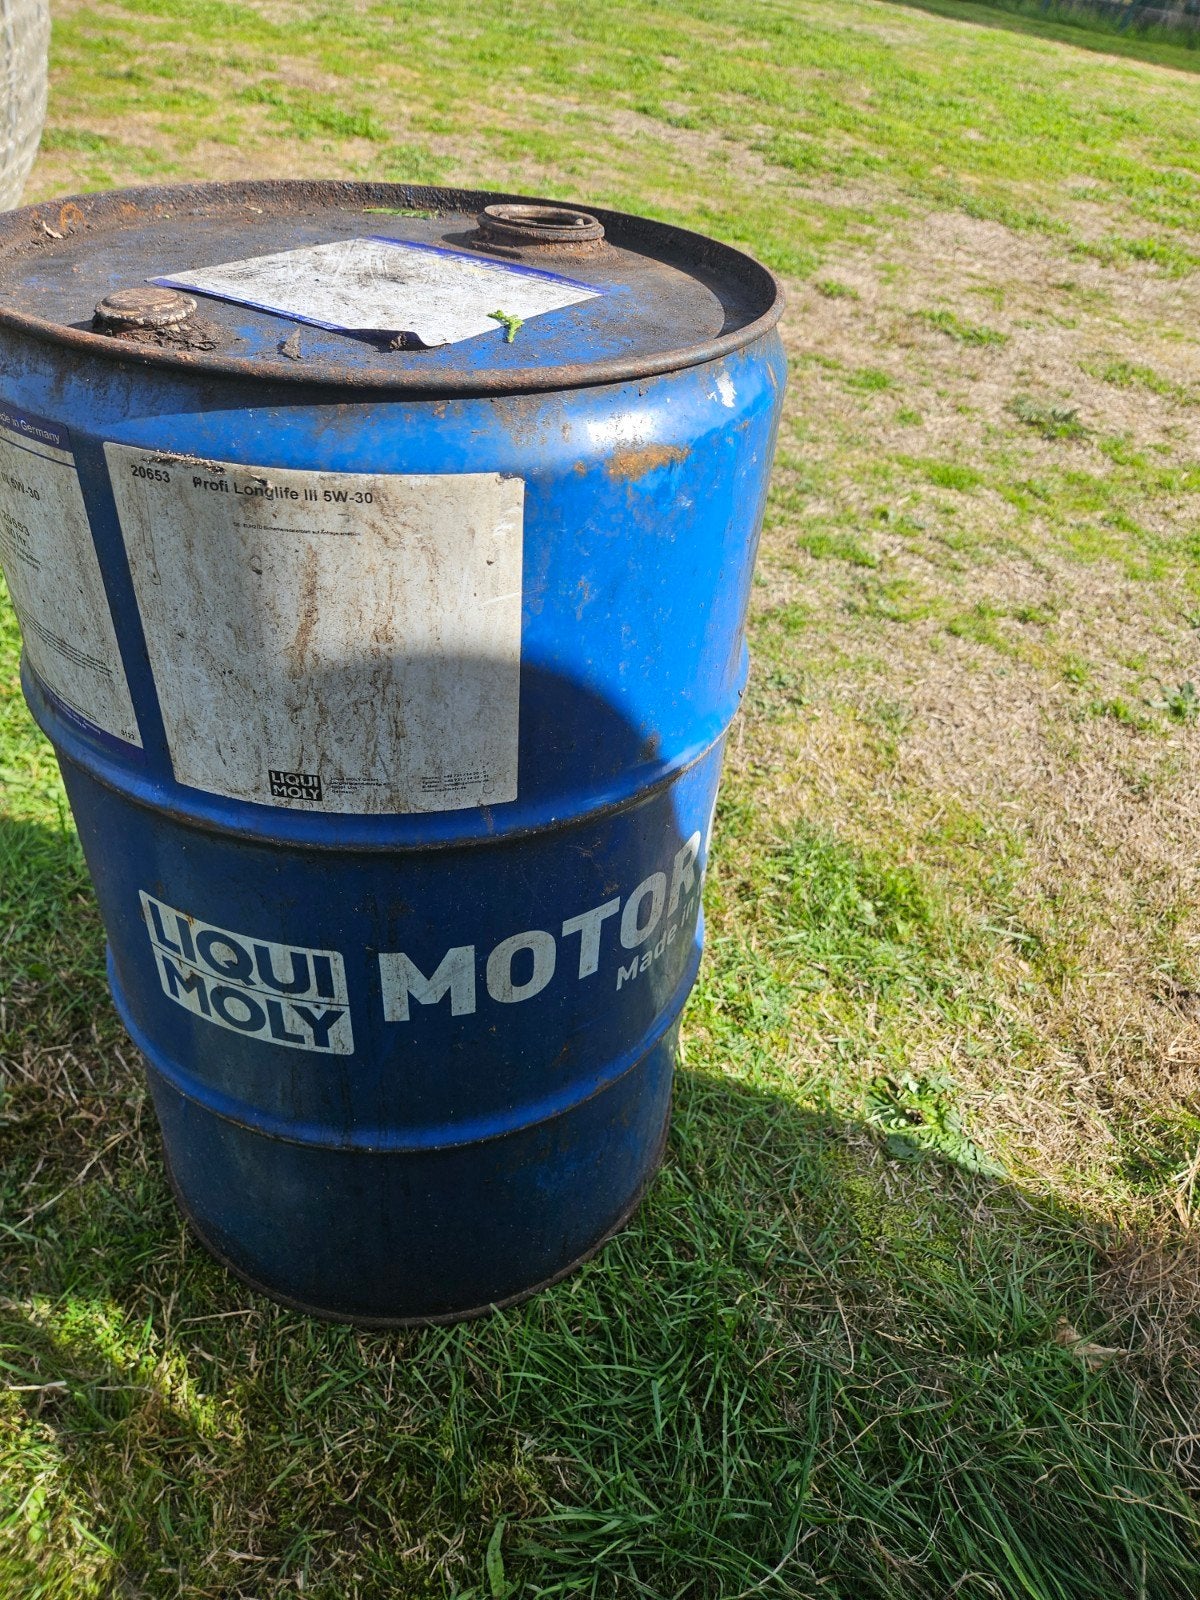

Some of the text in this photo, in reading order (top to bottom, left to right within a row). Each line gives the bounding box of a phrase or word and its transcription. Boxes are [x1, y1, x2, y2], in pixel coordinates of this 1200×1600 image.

[20, 419, 60, 445] Germany
[10, 477, 41, 502] 5W-30
[130, 464, 171, 484] 20653
[192, 476, 229, 493] Profi
[234, 482, 299, 500] Longlife
[324, 490, 374, 504] 5W-30
[271, 771, 319, 788] LIQUI
[272, 784, 319, 800] MOLY
[378, 830, 701, 1023] MOTOR
[616, 896, 695, 991] Made in
[145, 898, 336, 1000] LIQUI
[161, 954, 346, 1049] MOLY
